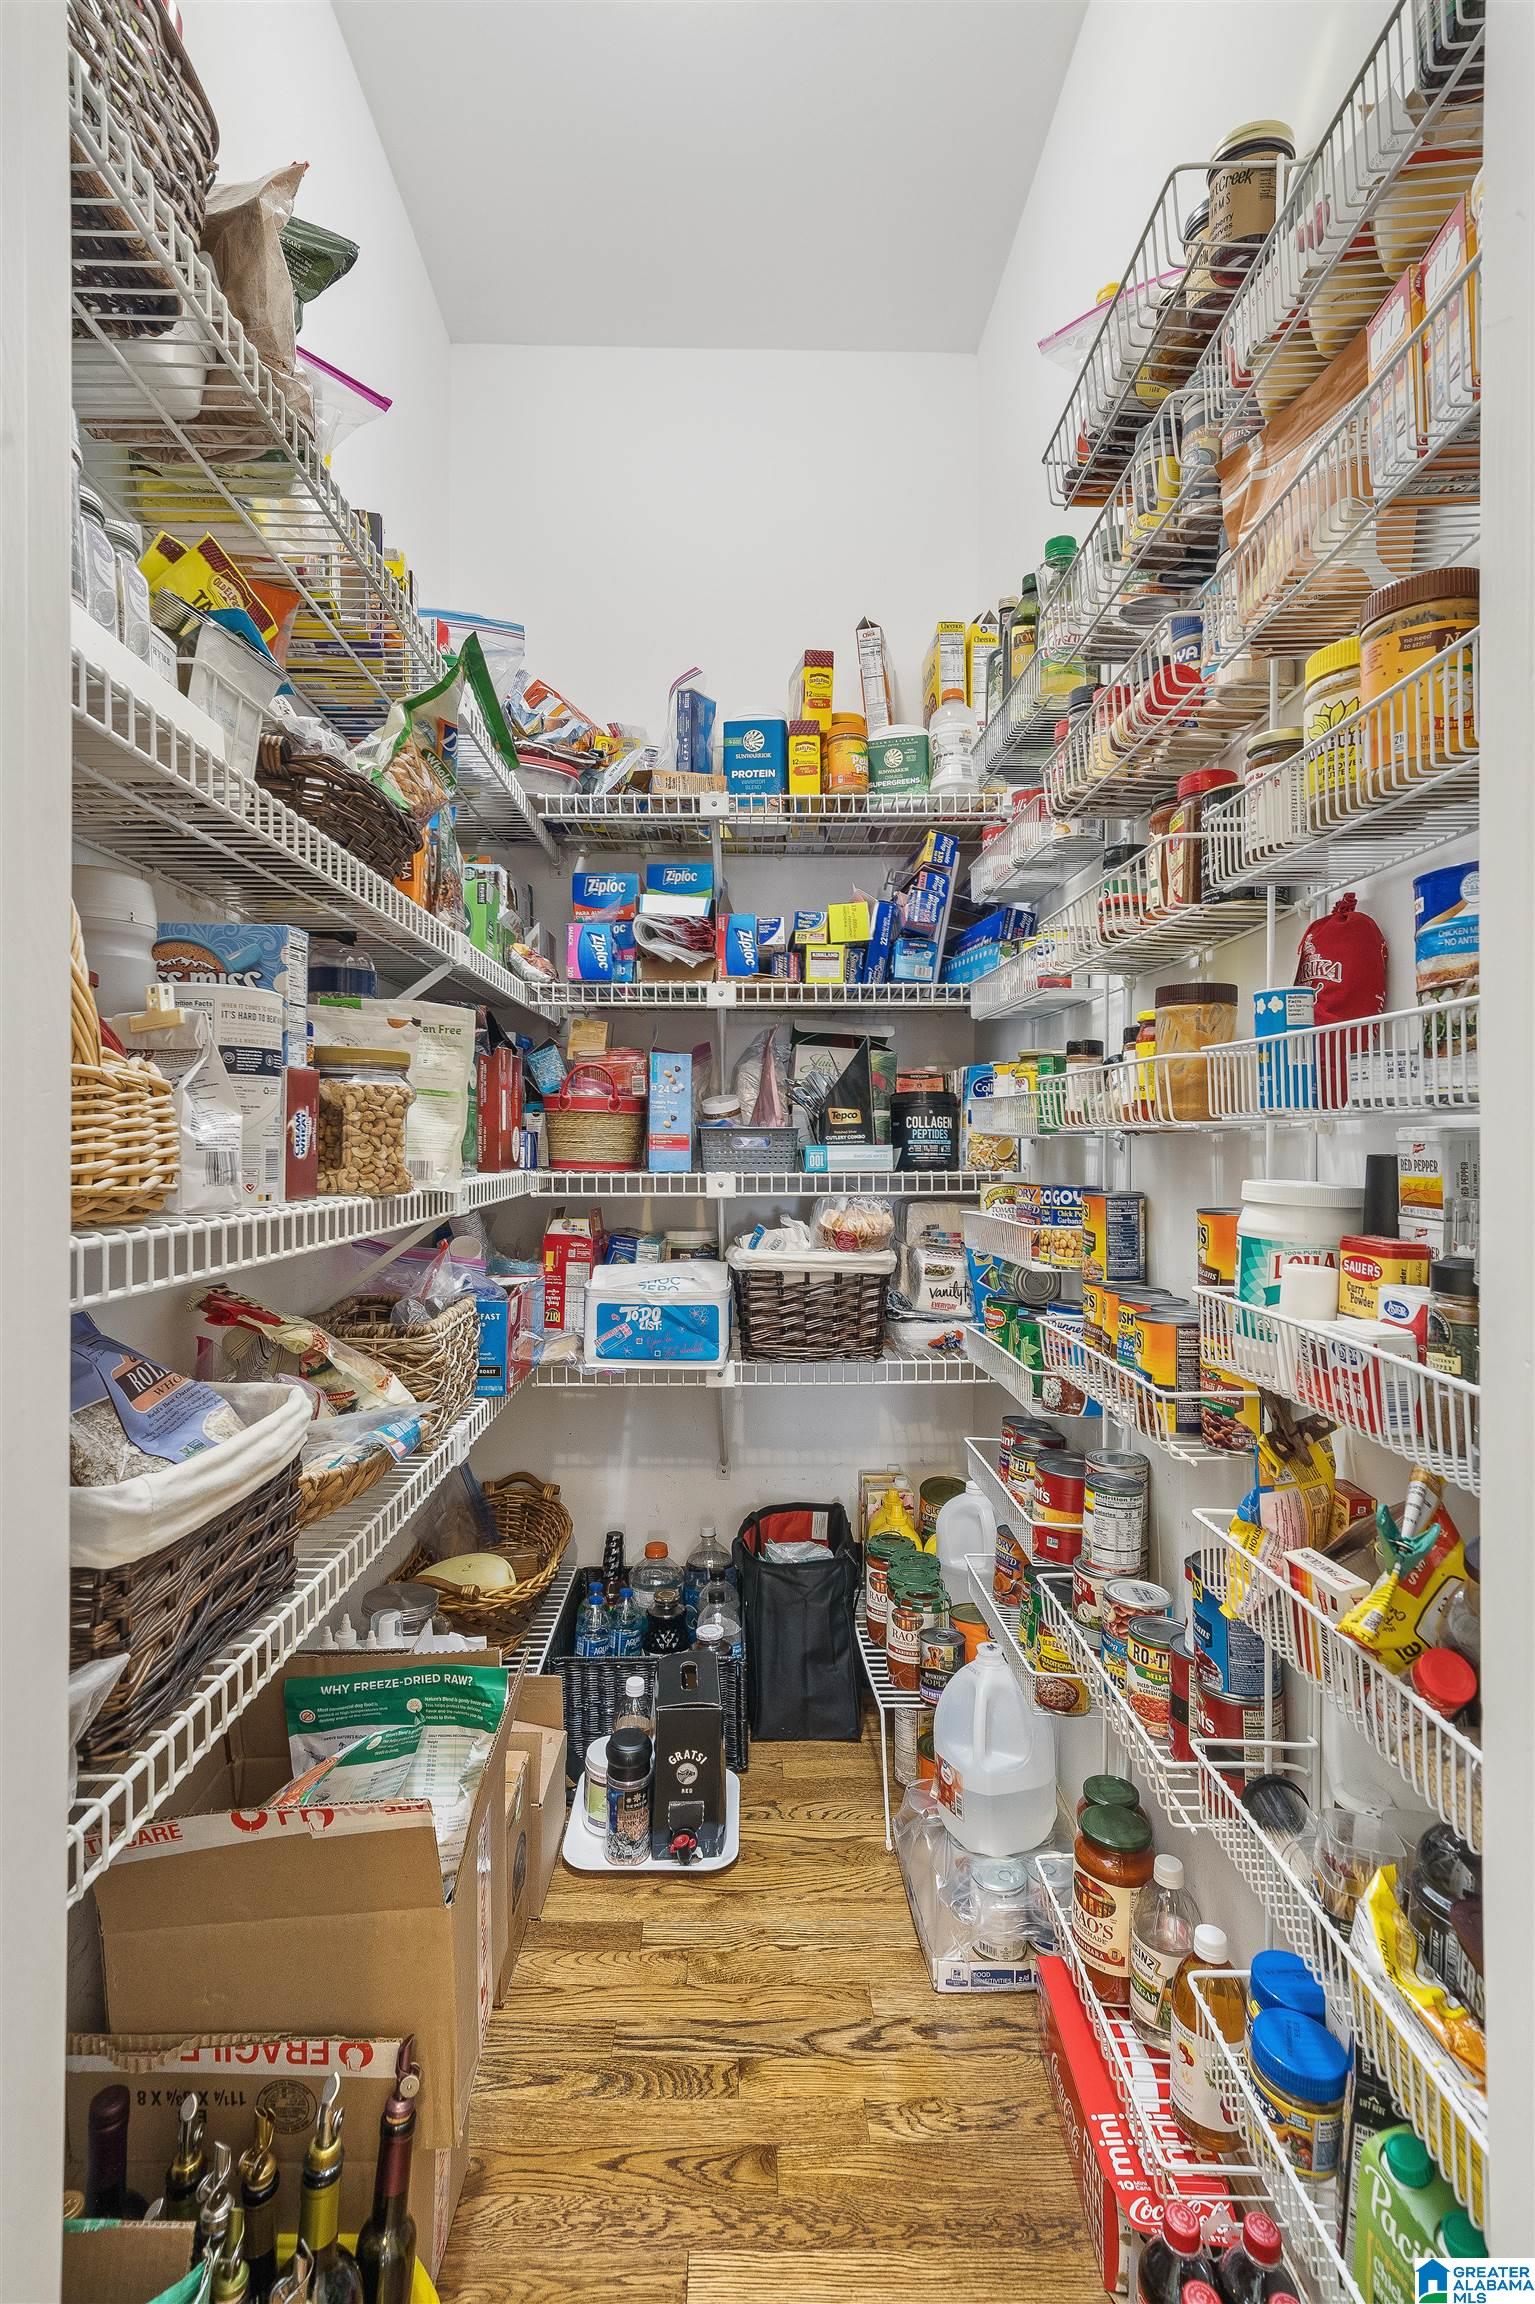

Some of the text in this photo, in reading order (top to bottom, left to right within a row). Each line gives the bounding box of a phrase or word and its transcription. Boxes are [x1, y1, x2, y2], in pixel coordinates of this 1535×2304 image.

[191, 589, 212, 612] TA
[974, 636, 997, 644] Cheerios
[1414, 632, 1432, 642] need
[1412, 640, 1425, 649] stir
[152, 646, 171, 667] HYME
[731, 769, 776, 778] PROTEIN
[868, 777, 921, 788] SUPERGREENS
[666, 870, 698, 886] Ziploc
[587, 877, 627, 896] Ziploc
[592, 932, 609, 970] Ziploc
[738, 929, 756, 967] Ziploc
[221, 1010, 236, 1019] IT'S
[238, 1011, 257, 1021] HARD
[439, 1024, 462, 1035] Free
[657, 1085, 670, 1093] 24
[831, 1110, 858, 1122] Tepco
[906, 1115, 953, 1129] COLLAGEN
[912, 1129, 949, 1139] PEPTIDES
[1400, 1159, 1439, 1173] RED PEPPER
[1053, 1190, 1083, 1206] GOY
[992, 1206, 1015, 1214] TOMAT
[1343, 1259, 1382, 1278] SAUER'S
[1347, 1281, 1366, 1298] Curry
[931, 1302, 958, 1310] EVERYDAY
[1350, 1292, 1375, 1309] Powder
[545, 1311, 561, 1322] RITZ
[153, 1375, 184, 1396] WHO
[1095, 1491, 1128, 1503] Nutrition
[1095, 1508, 1116, 1518] Calories
[868, 1592, 888, 1604] RAO
[320, 1673, 473, 1696] WHY FREEZE-DRIED RAW?
[1150, 1684, 1170, 1694] TOMAT
[668, 1749, 708, 1765] GRATSI
[1132, 1943, 1155, 1970] EINZ
[1091, 2113, 1135, 2176] mini
[1117, 2180, 1134, 2191] 10
